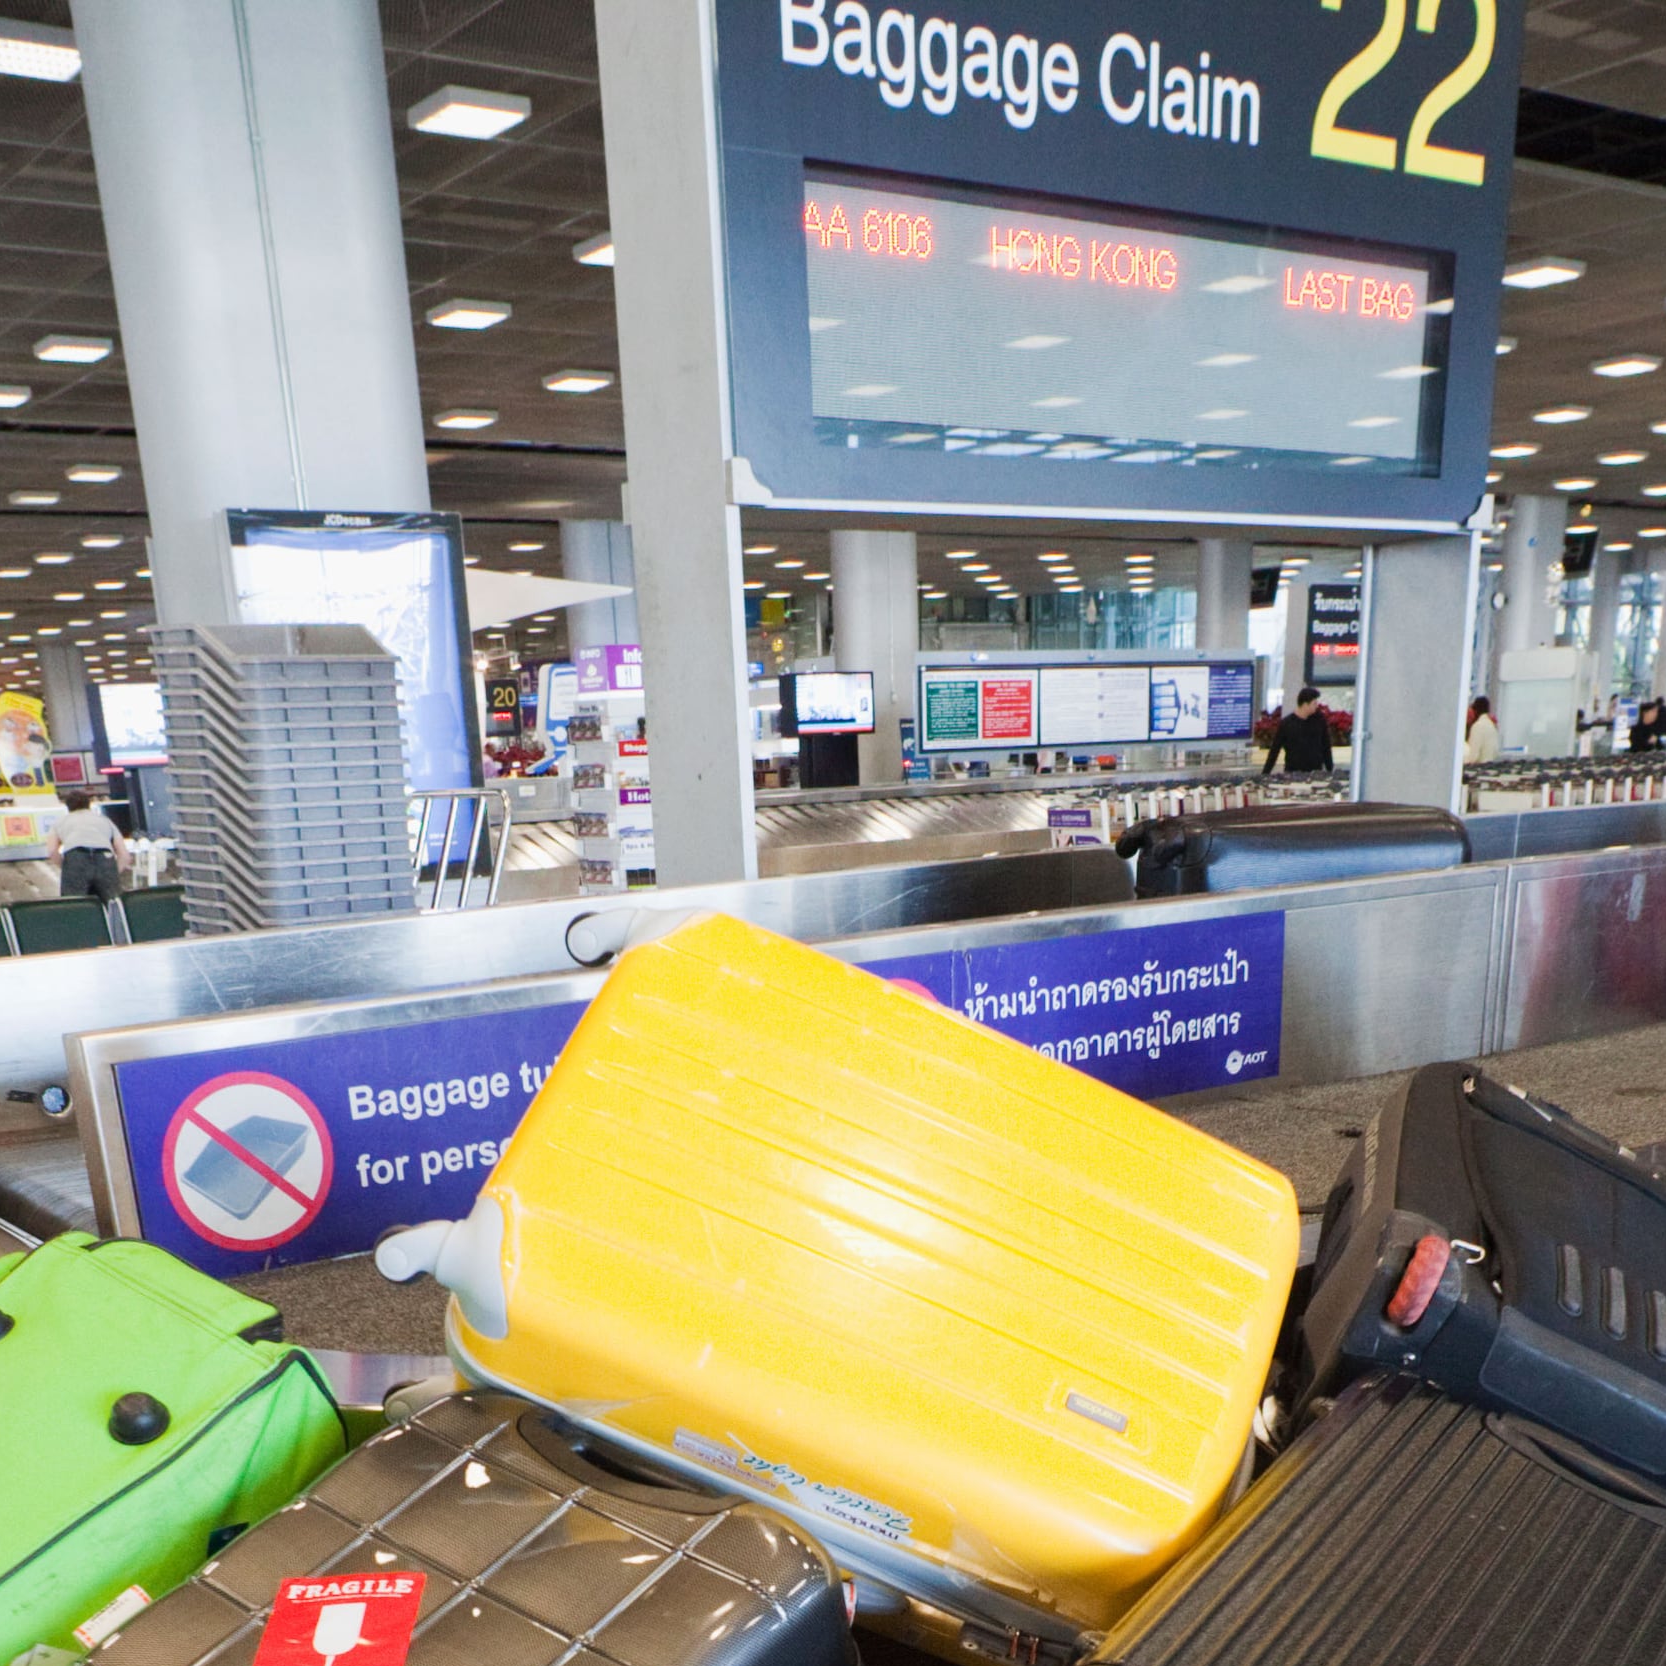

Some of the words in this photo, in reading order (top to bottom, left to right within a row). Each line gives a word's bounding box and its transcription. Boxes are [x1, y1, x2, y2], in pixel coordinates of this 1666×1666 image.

[780, 0, 1080, 130] Baggage
[1099, 33, 1261, 147] Claim
[1310, 0, 1497, 187] 22
[862, 208, 933, 259] 6106
[990, 226, 1083, 279] HONG
[1089, 239, 1177, 291] KONG
[1285, 267, 1355, 313] LAST
[1361, 277, 1414, 320] BAG
[493, 686, 517, 708] 20
[1243, 1051, 1268, 1066] AOT
[348, 1071, 511, 1121] Baggage
[356, 1153, 410, 1188] for
[286, 1578, 415, 1600] FRAGILE
